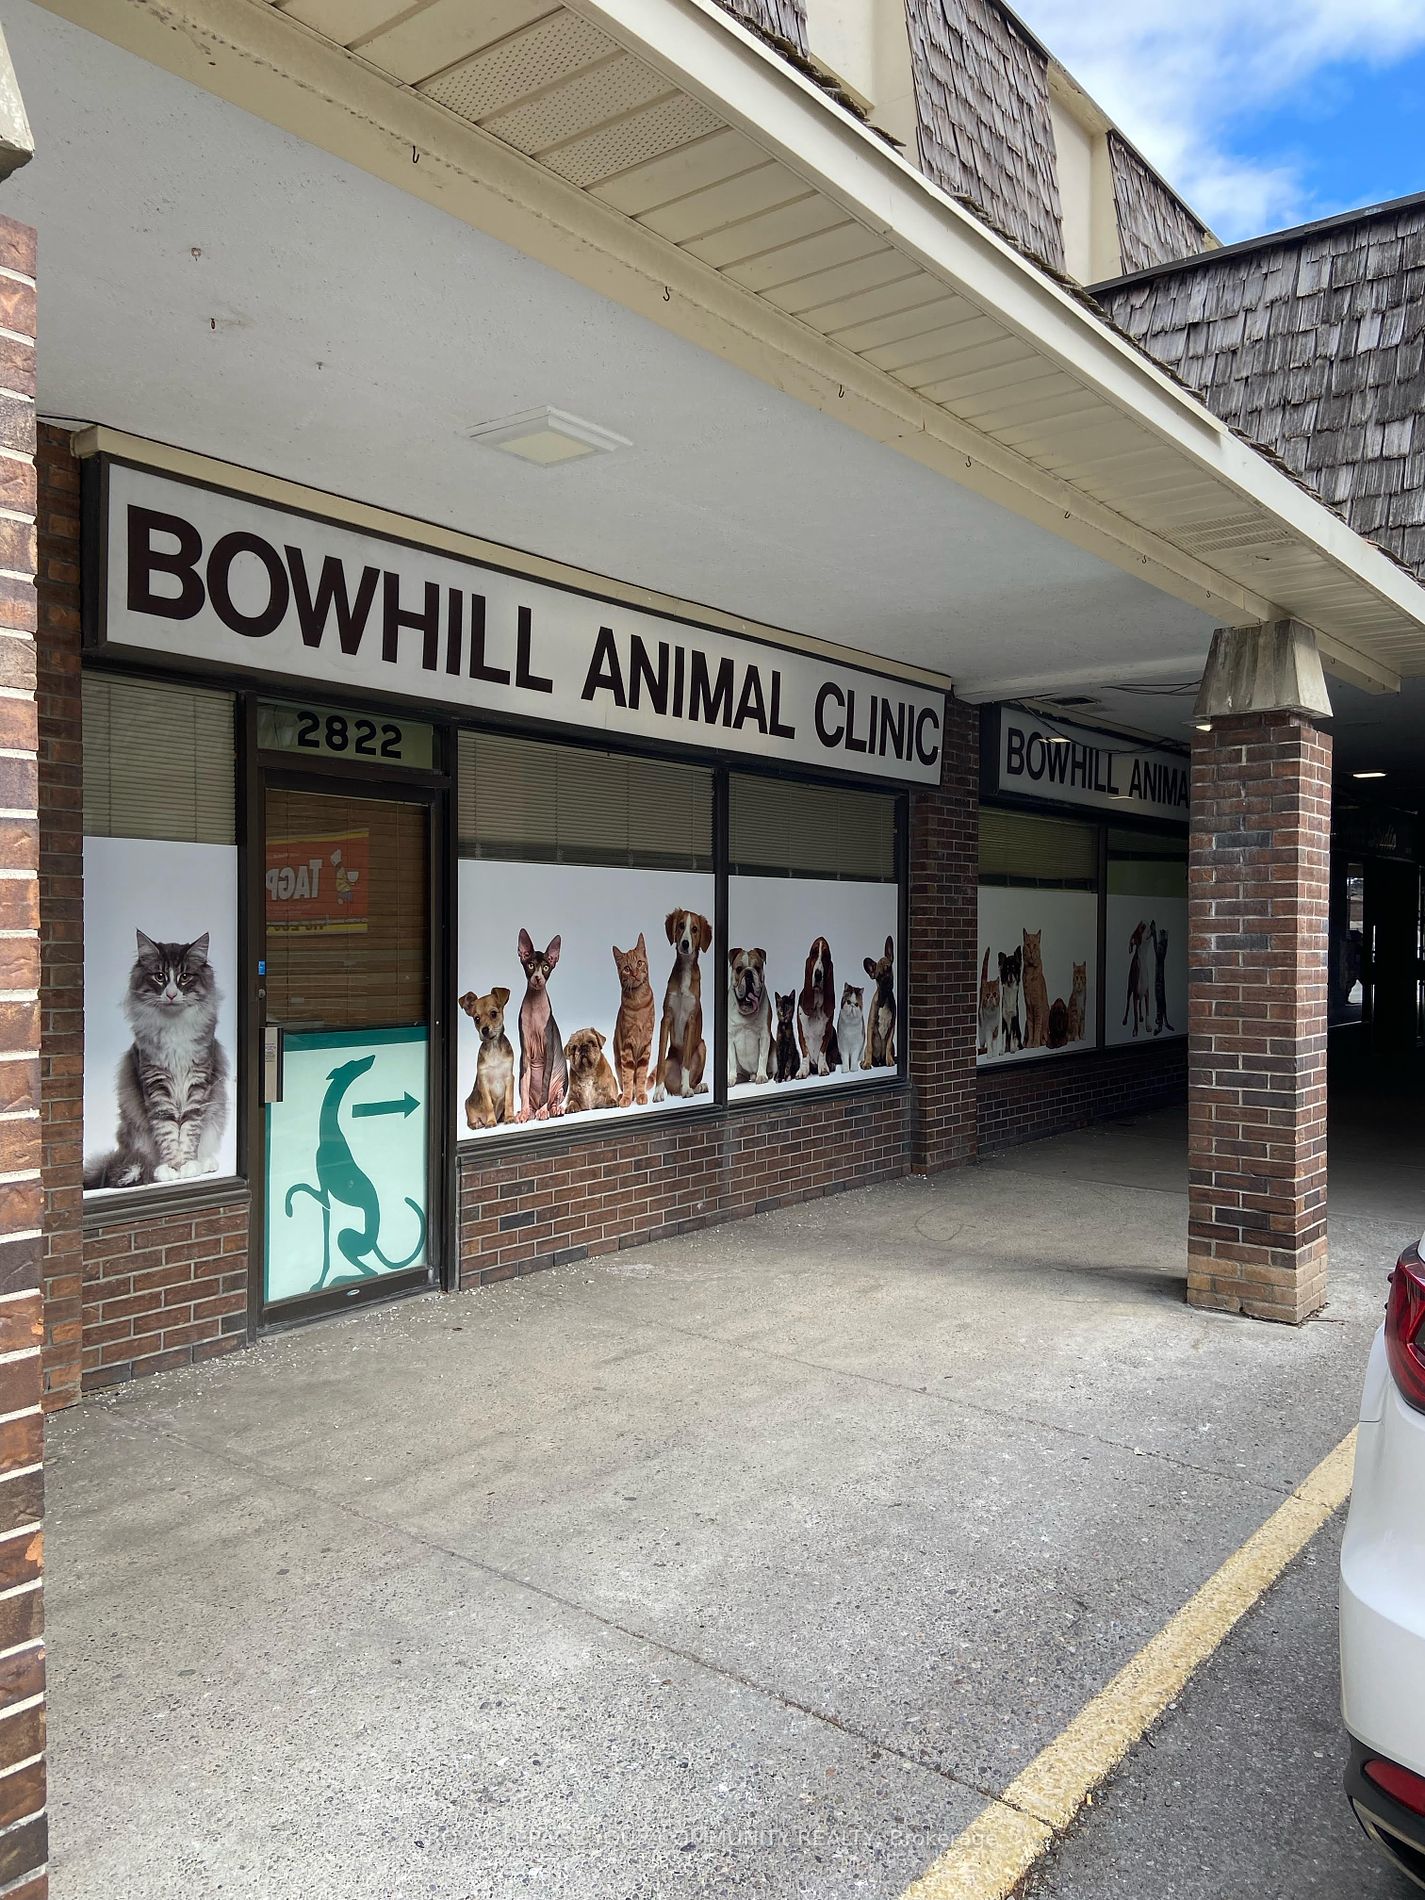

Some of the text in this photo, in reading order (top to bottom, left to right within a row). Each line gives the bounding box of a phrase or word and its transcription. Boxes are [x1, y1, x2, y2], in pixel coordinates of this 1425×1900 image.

[127, 504, 940, 767] BOWHILL ANIMAL CLINIC
[297, 710, 402, 760] 2822
[1006, 727, 1119, 795] BOWHILL
